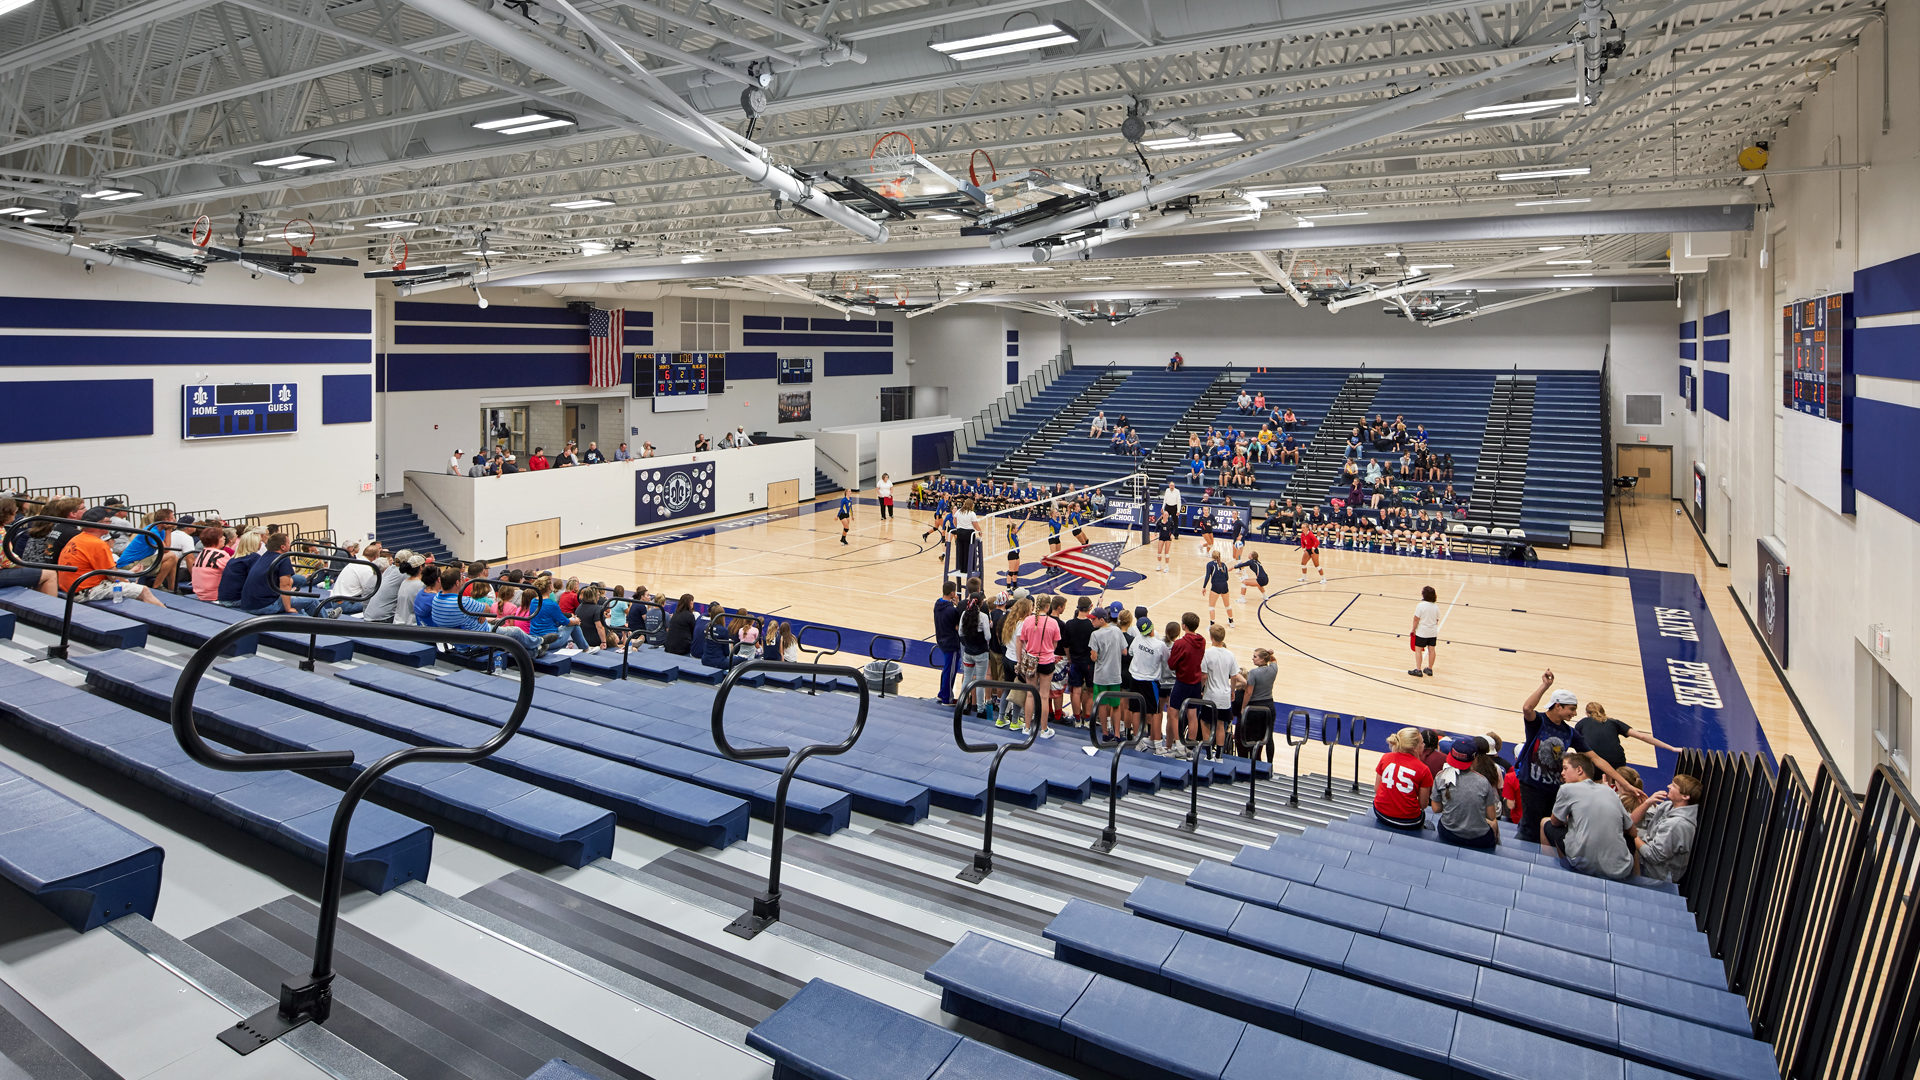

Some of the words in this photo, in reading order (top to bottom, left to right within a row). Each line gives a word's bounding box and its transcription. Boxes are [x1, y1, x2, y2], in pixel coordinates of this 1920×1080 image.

[664, 370, 670, 380] 6
[192, 406, 218, 416] HOME
[267, 403, 293, 412] GUEST
[1109, 500, 1125, 508] SAINT
[1116, 507, 1132, 515] HIGH
[1111, 514, 1136, 522] SCHOOL
[605, 533, 690, 551] SAINT
[1653, 606, 1700, 642] SAINT
[1666, 657, 1724, 709] PETER
[1381, 762, 1417, 794] 45
